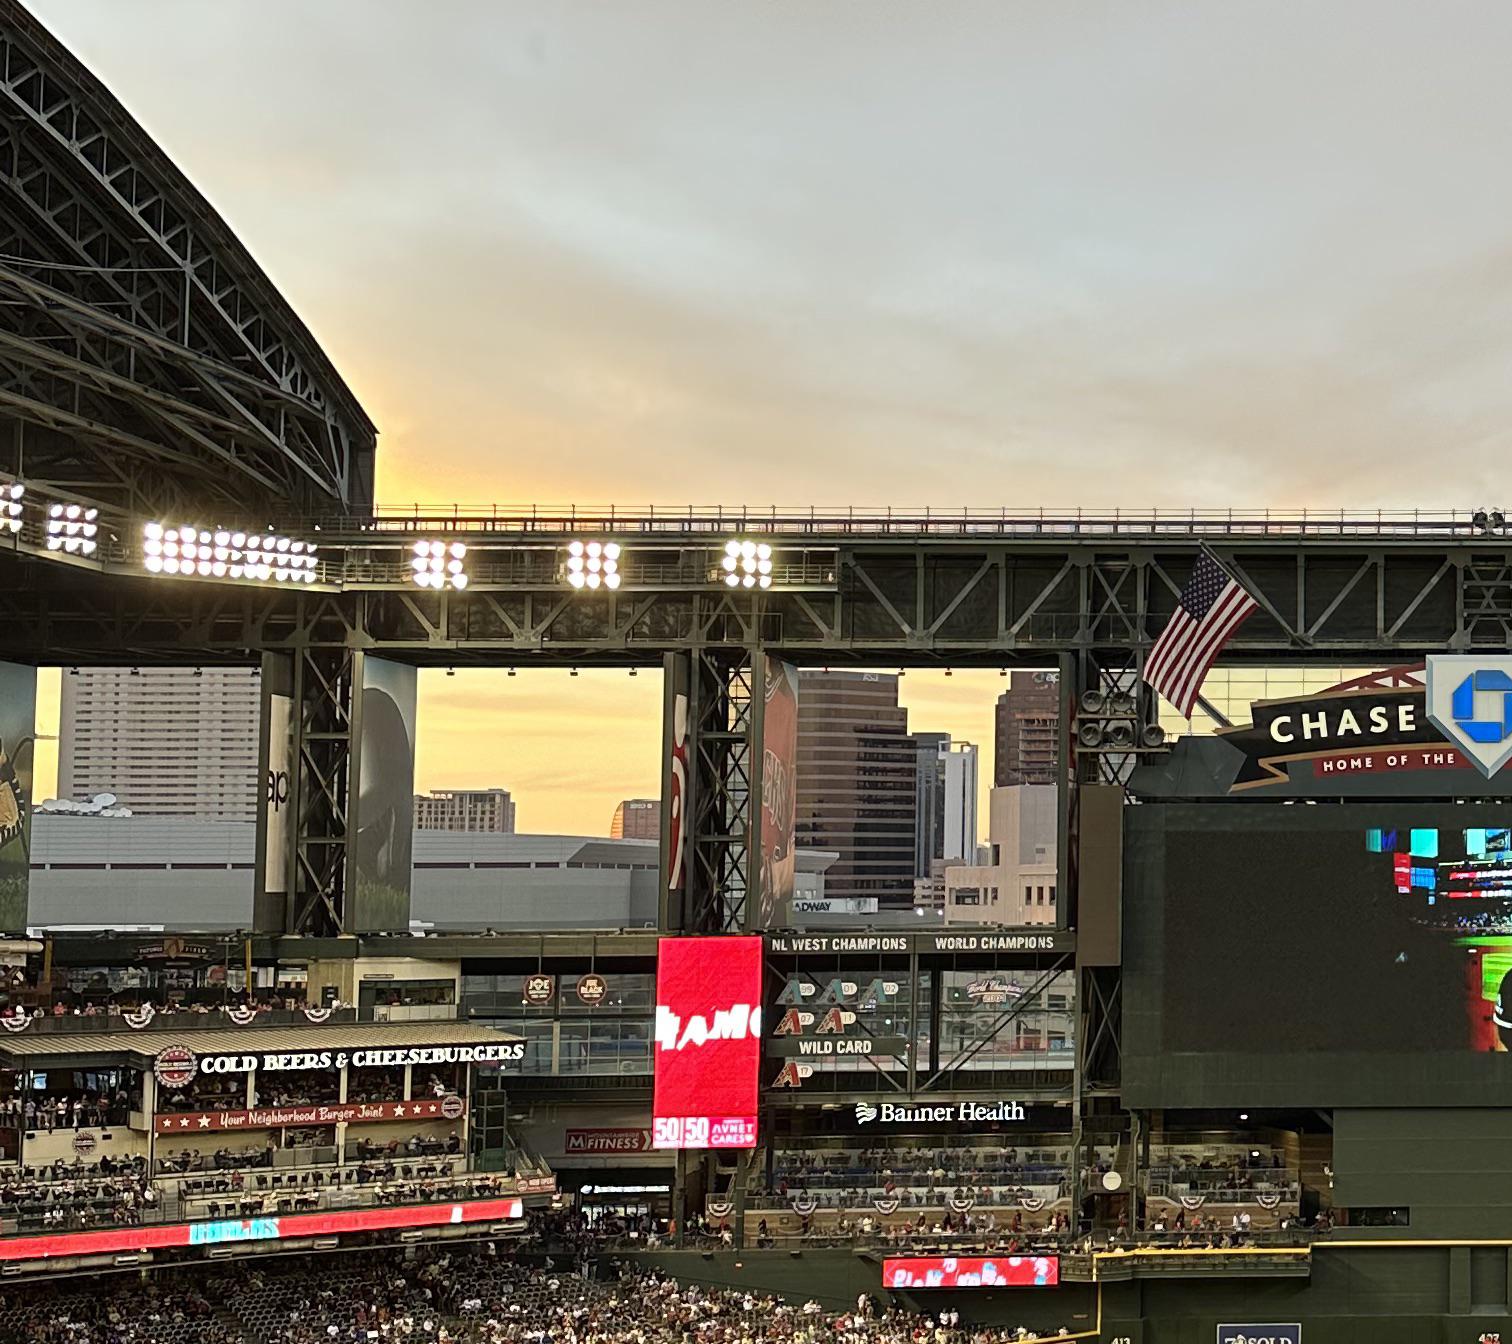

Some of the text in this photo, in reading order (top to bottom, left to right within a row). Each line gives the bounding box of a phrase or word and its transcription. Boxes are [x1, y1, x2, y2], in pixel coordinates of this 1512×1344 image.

[1269, 704, 1416, 743] CHASE
[1323, 758, 1373, 772] HOME
[1387, 754, 1408, 766] OF
[1422, 753, 1455, 765] THE
[772, 937, 907, 951] NL WEST CHAMPIONS
[935, 936, 1054, 950] WORLD CHAMPIONS
[799, 1041, 872, 1054] WILD CARD
[201, 1055, 258, 1074] COLD
[263, 1052, 332, 1071] BEERS
[336, 1053, 348, 1069] &
[352, 1044, 525, 1067] CHEESEBURGERS
[220, 1104, 384, 1128] Your Neighborhood Burger Joint
[880, 1101, 1025, 1122] Banner Health
[587, 1137, 639, 1149] FITNESS
